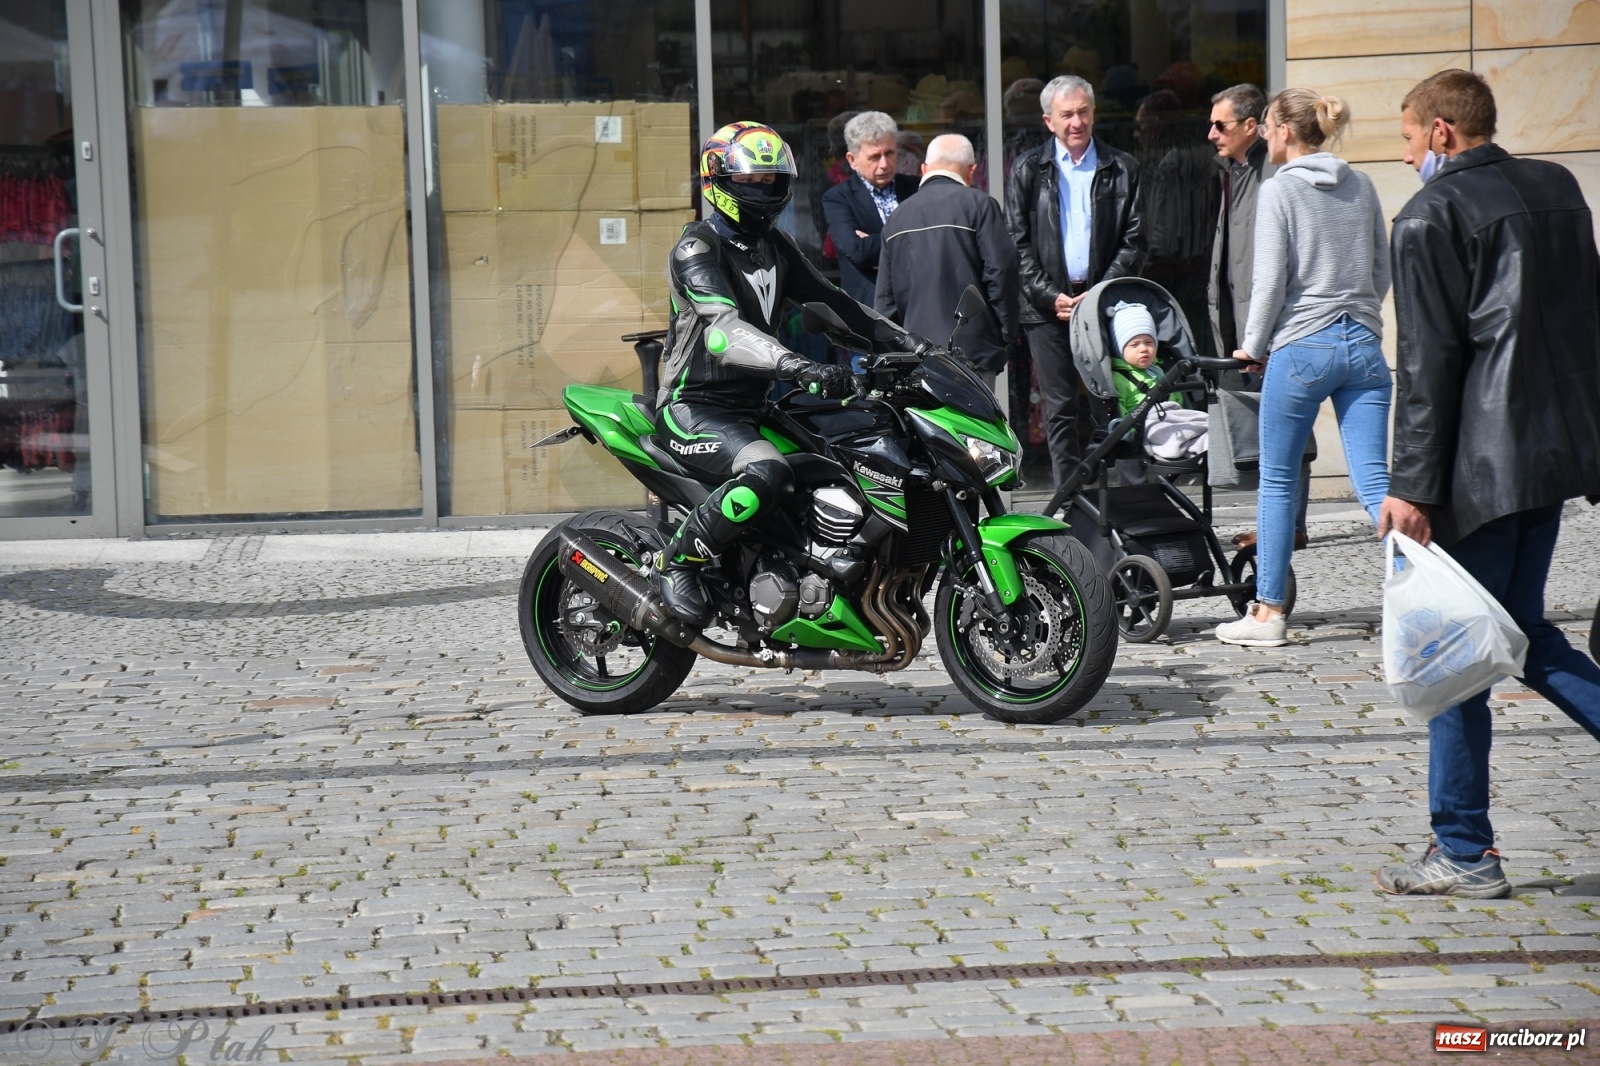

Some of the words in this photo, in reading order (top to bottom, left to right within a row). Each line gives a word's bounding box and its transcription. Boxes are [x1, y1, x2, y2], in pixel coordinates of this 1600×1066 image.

[730, 328, 787, 354] DAINESE
[1131, 402, 1148, 418] bloom
[670, 439, 722, 455] DAINESE
[853, 460, 904, 488] Kawasaki
